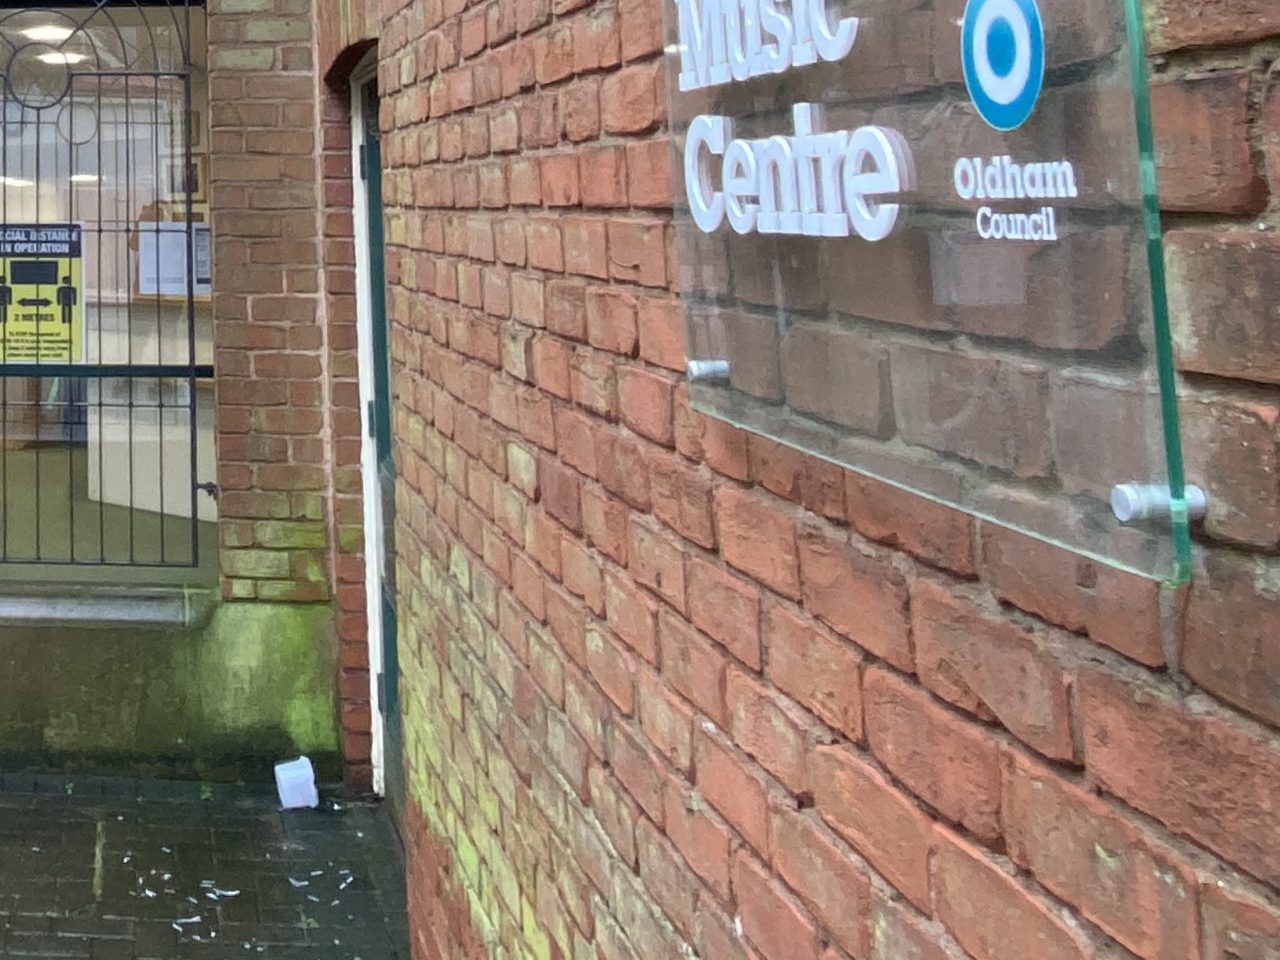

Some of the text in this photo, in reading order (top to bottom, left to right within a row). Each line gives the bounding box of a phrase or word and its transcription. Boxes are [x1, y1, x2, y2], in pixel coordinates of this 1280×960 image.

[684, 102, 907, 242] Centre
[953, 154, 1078, 200] Oldham
[976, 205, 1058, 241] Council
